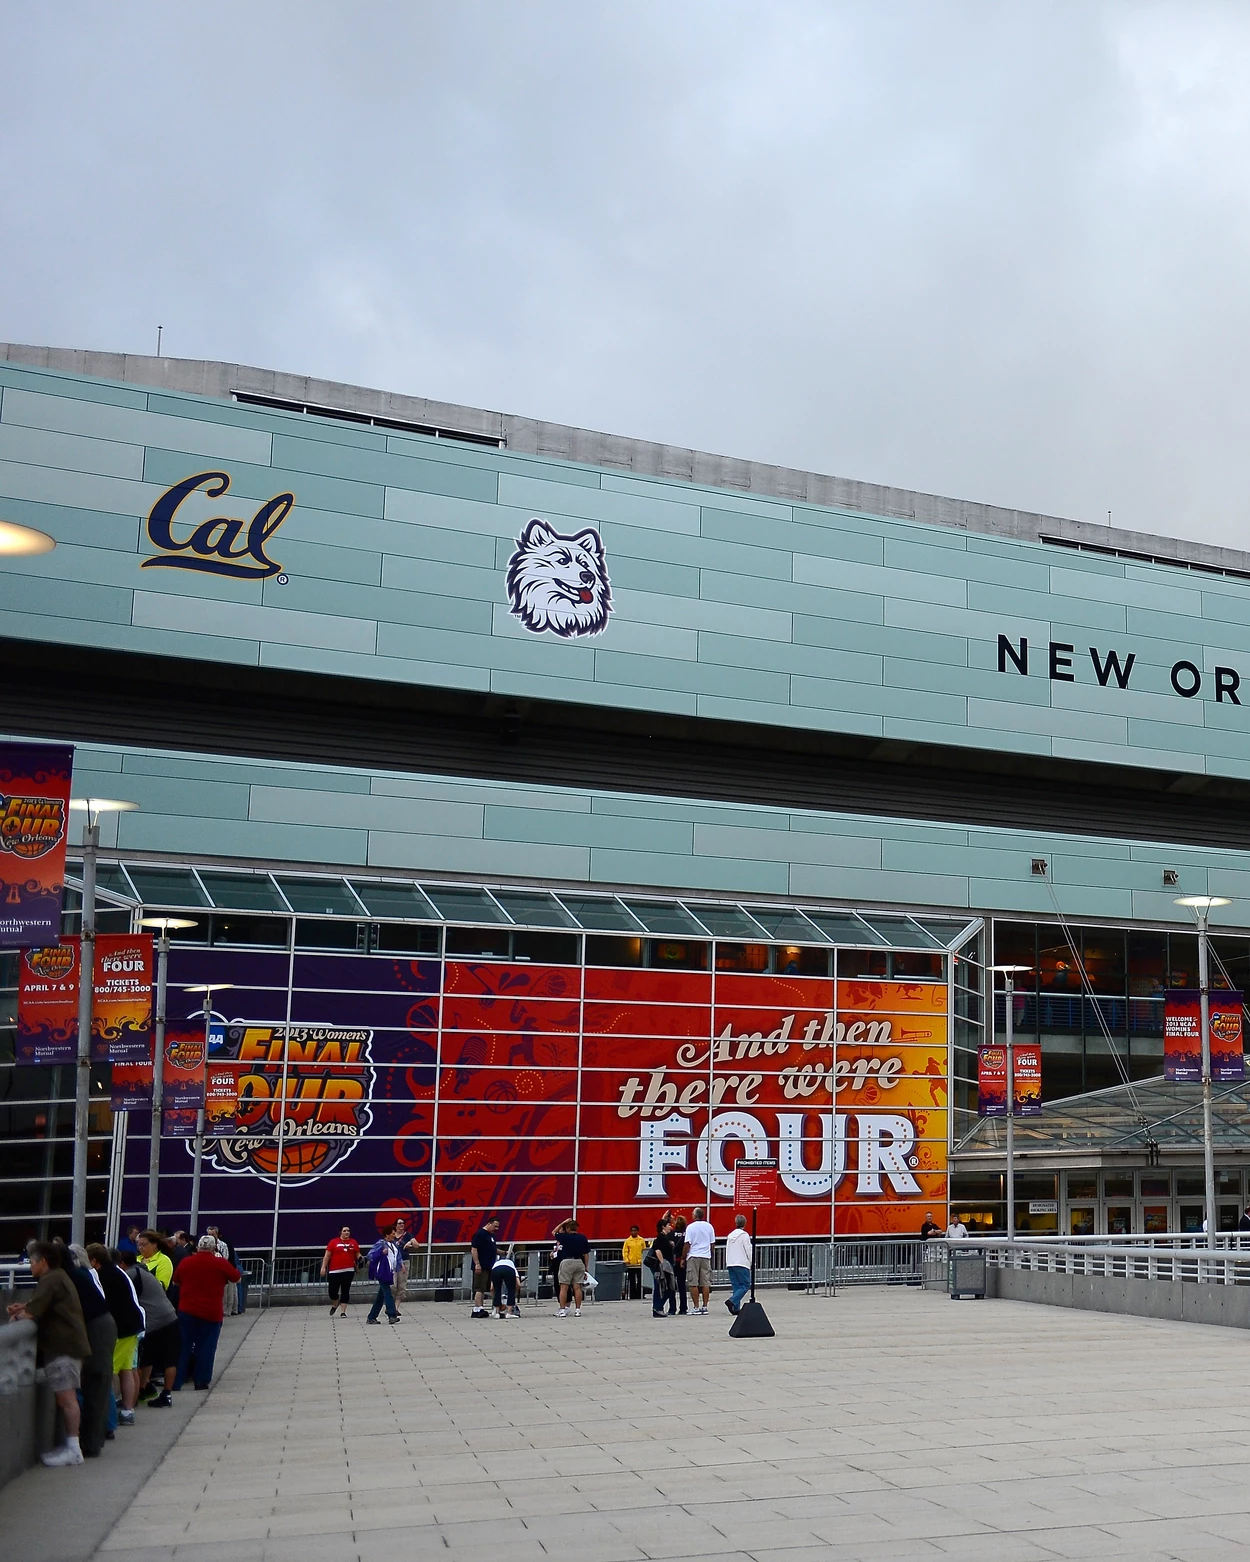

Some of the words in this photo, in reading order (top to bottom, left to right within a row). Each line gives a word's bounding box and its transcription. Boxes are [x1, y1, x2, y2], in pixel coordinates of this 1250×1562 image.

[140, 470, 296, 580] Cal
[997, 633, 1136, 689] NEW
[8, 799, 60, 818] FINAL
[0, 810, 60, 837] OUR
[22, 833, 58, 843] Orleans
[0, 918, 52, 926] orthwestern
[0, 925, 23, 933] utual
[42, 948, 72, 957] FINAL
[31, 954, 72, 968] FOUR
[103, 961, 145, 973] FOUR
[24, 984, 50, 992] APRIL
[94, 985, 151, 993] 800/745-3000
[106, 978, 140, 986] TICKETS
[1213, 1020, 1240, 1031] FOUR
[273, 1027, 308, 1042] 2013
[310, 1028, 367, 1041] Women's
[676, 1013, 795, 1068] And
[803, 1011, 893, 1050] then
[170, 1049, 202, 1060] FOUR
[237, 1028, 365, 1074] FINAL
[616, 1065, 763, 1119] there
[778, 1057, 903, 1099] were
[236, 1074, 365, 1127] OUR
[272, 1118, 358, 1142] Orleans
[193, 1126, 266, 1164] New
[634, 1111, 925, 1198] FOUR
